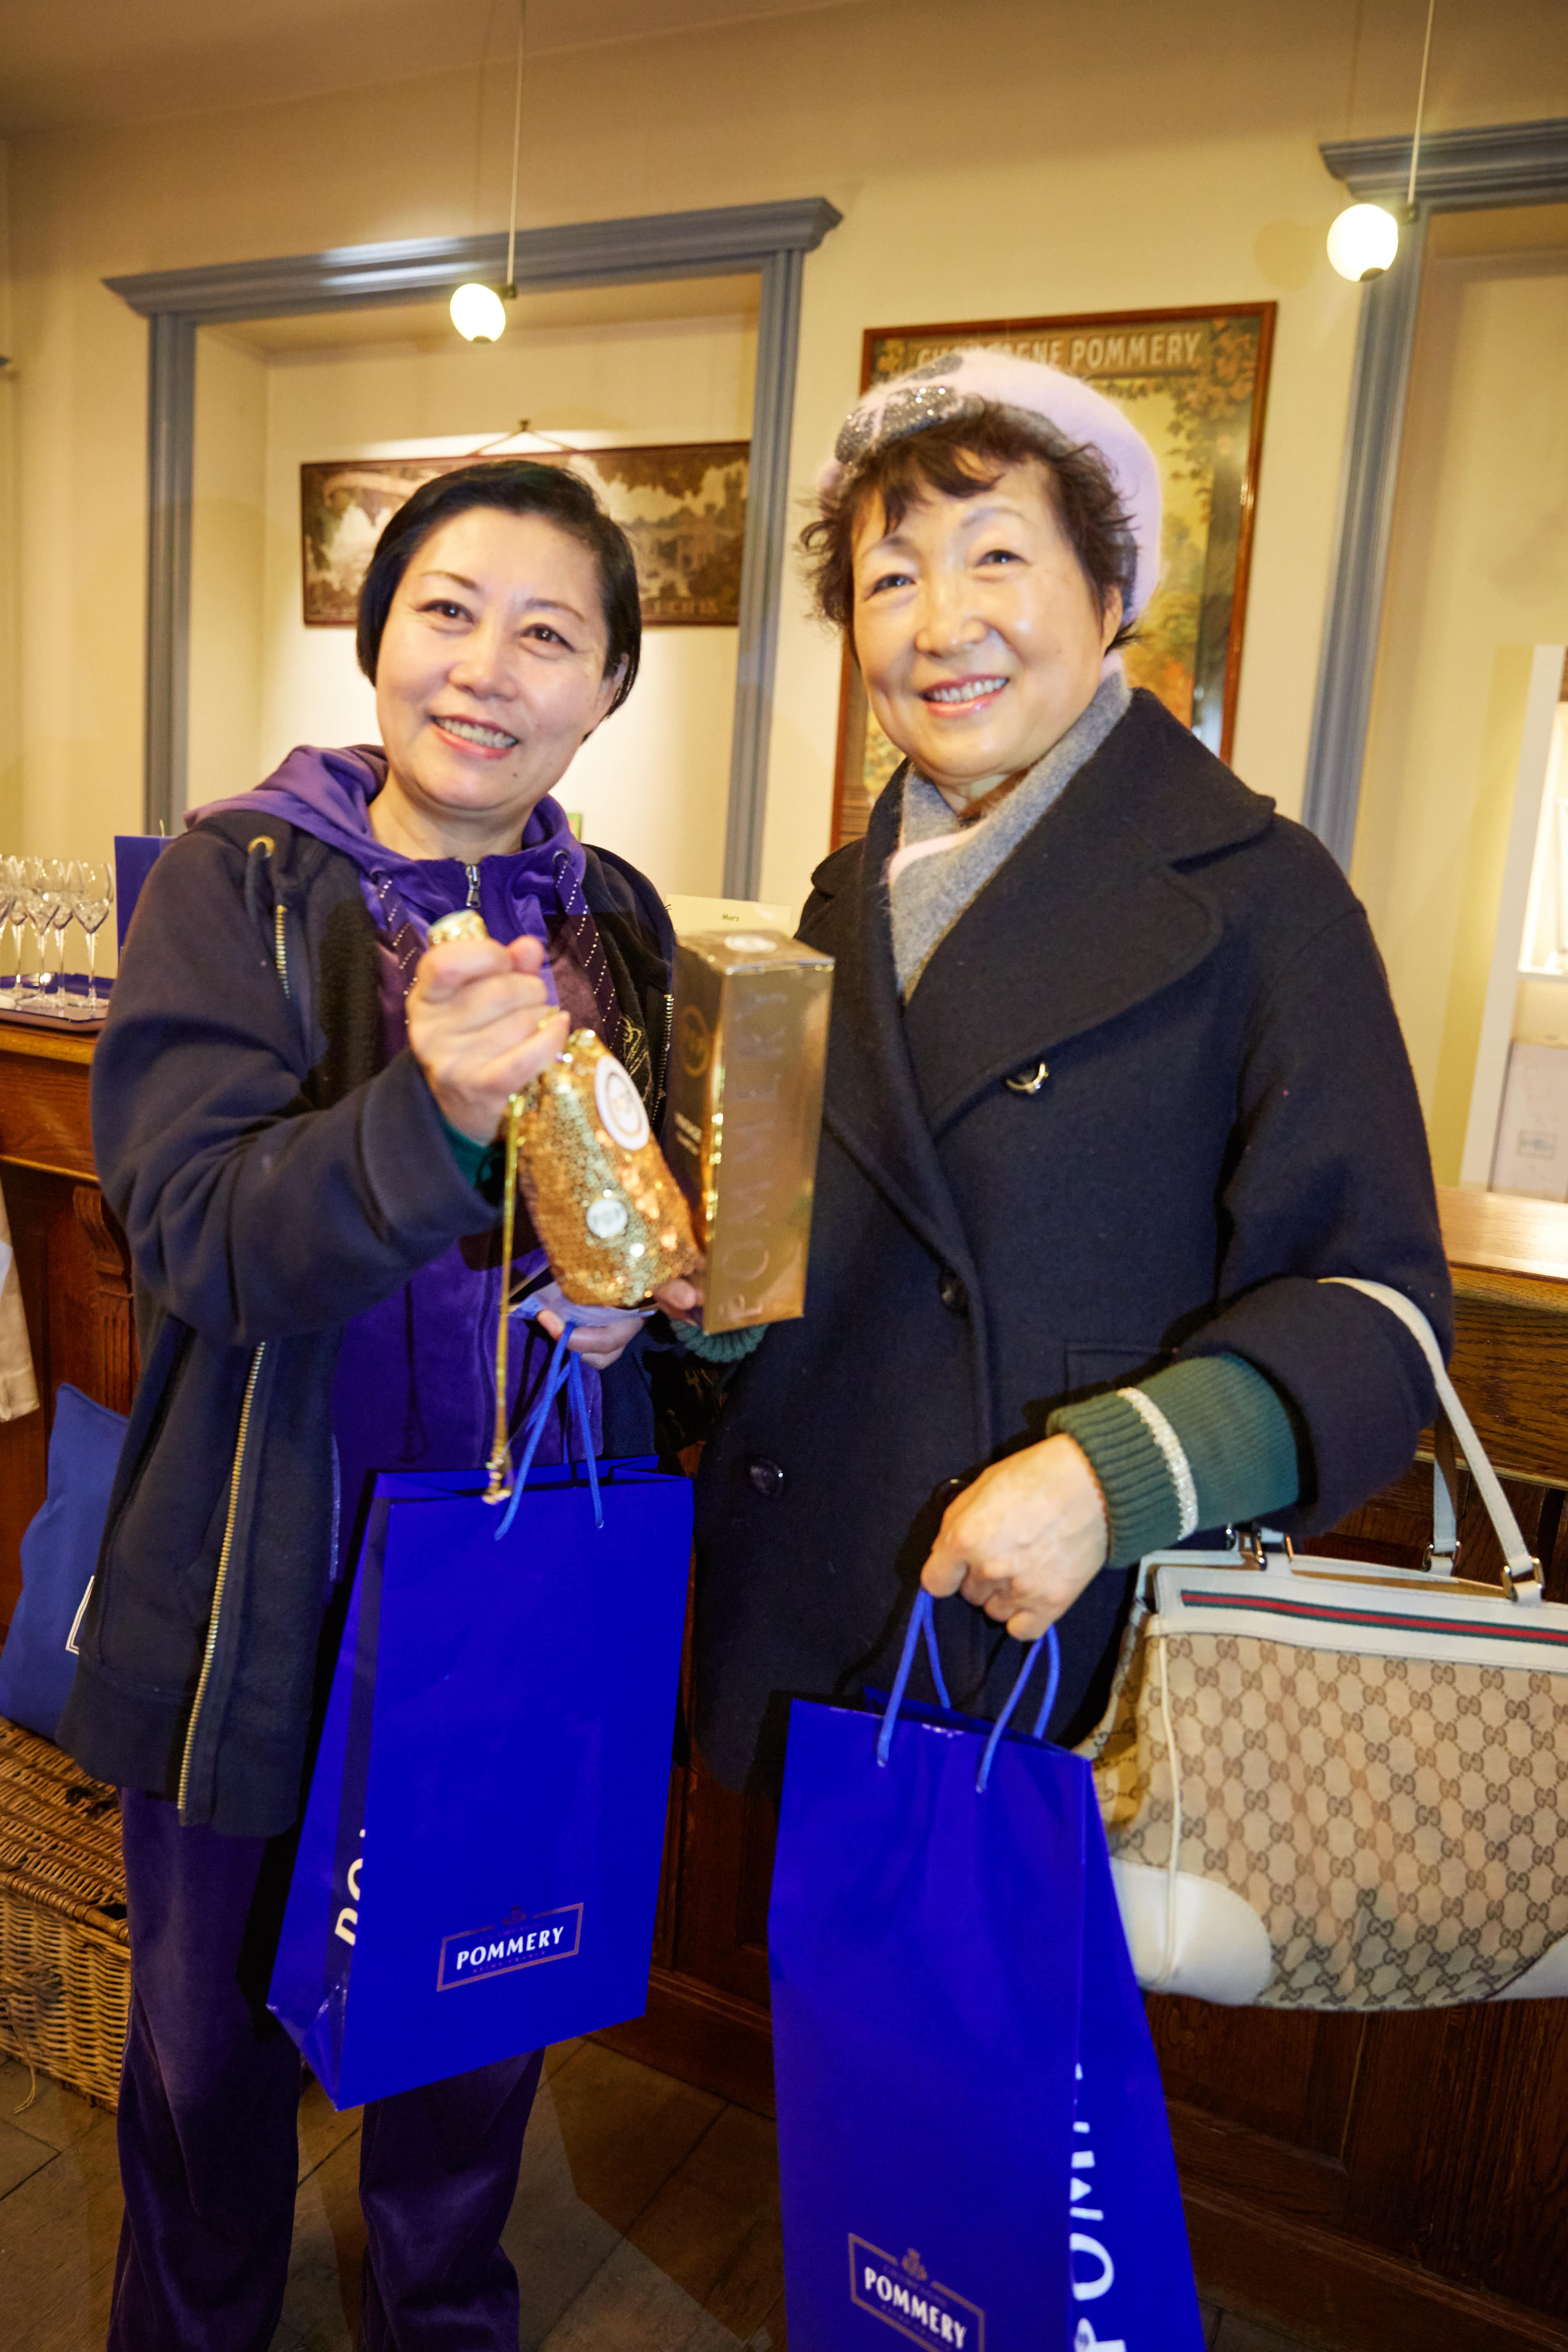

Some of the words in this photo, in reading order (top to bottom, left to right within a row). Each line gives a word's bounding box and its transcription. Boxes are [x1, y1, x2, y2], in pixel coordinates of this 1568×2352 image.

[1070, 332, 1200, 368] POMMERY
[456, 1926, 564, 1970] POMMERY
[864, 2266, 967, 2349] POMMERY
